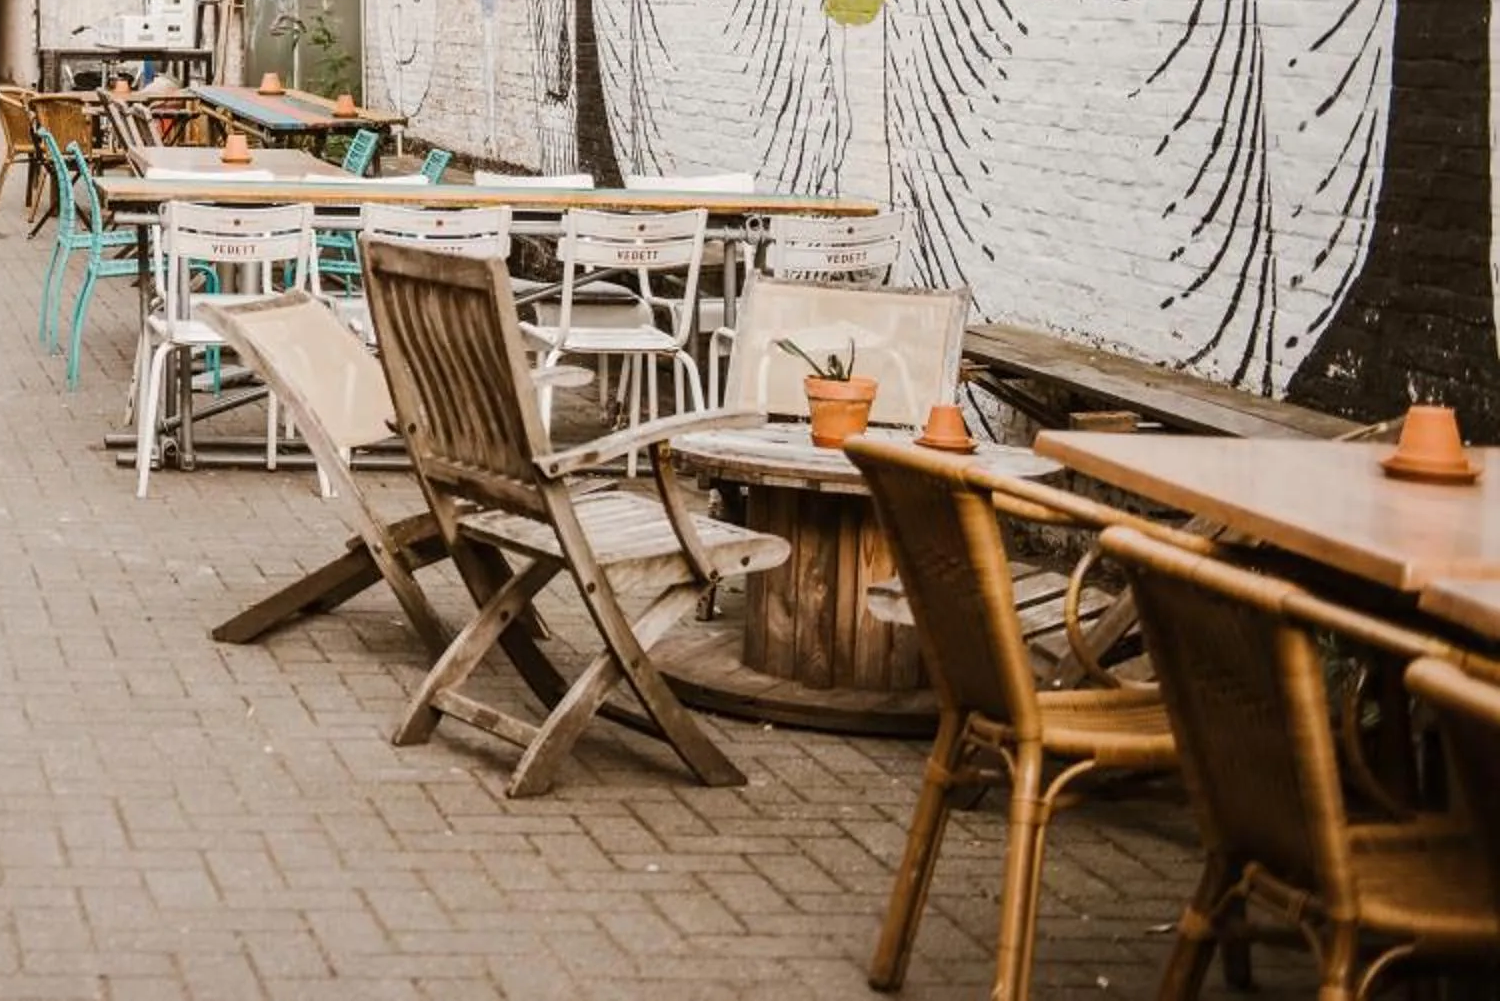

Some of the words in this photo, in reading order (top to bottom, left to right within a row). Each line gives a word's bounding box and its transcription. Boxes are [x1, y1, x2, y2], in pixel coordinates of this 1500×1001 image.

[212, 245, 256, 255] VEDETT
[617, 250, 658, 260] VEDETT
[826, 251, 867, 264] VEDETT
